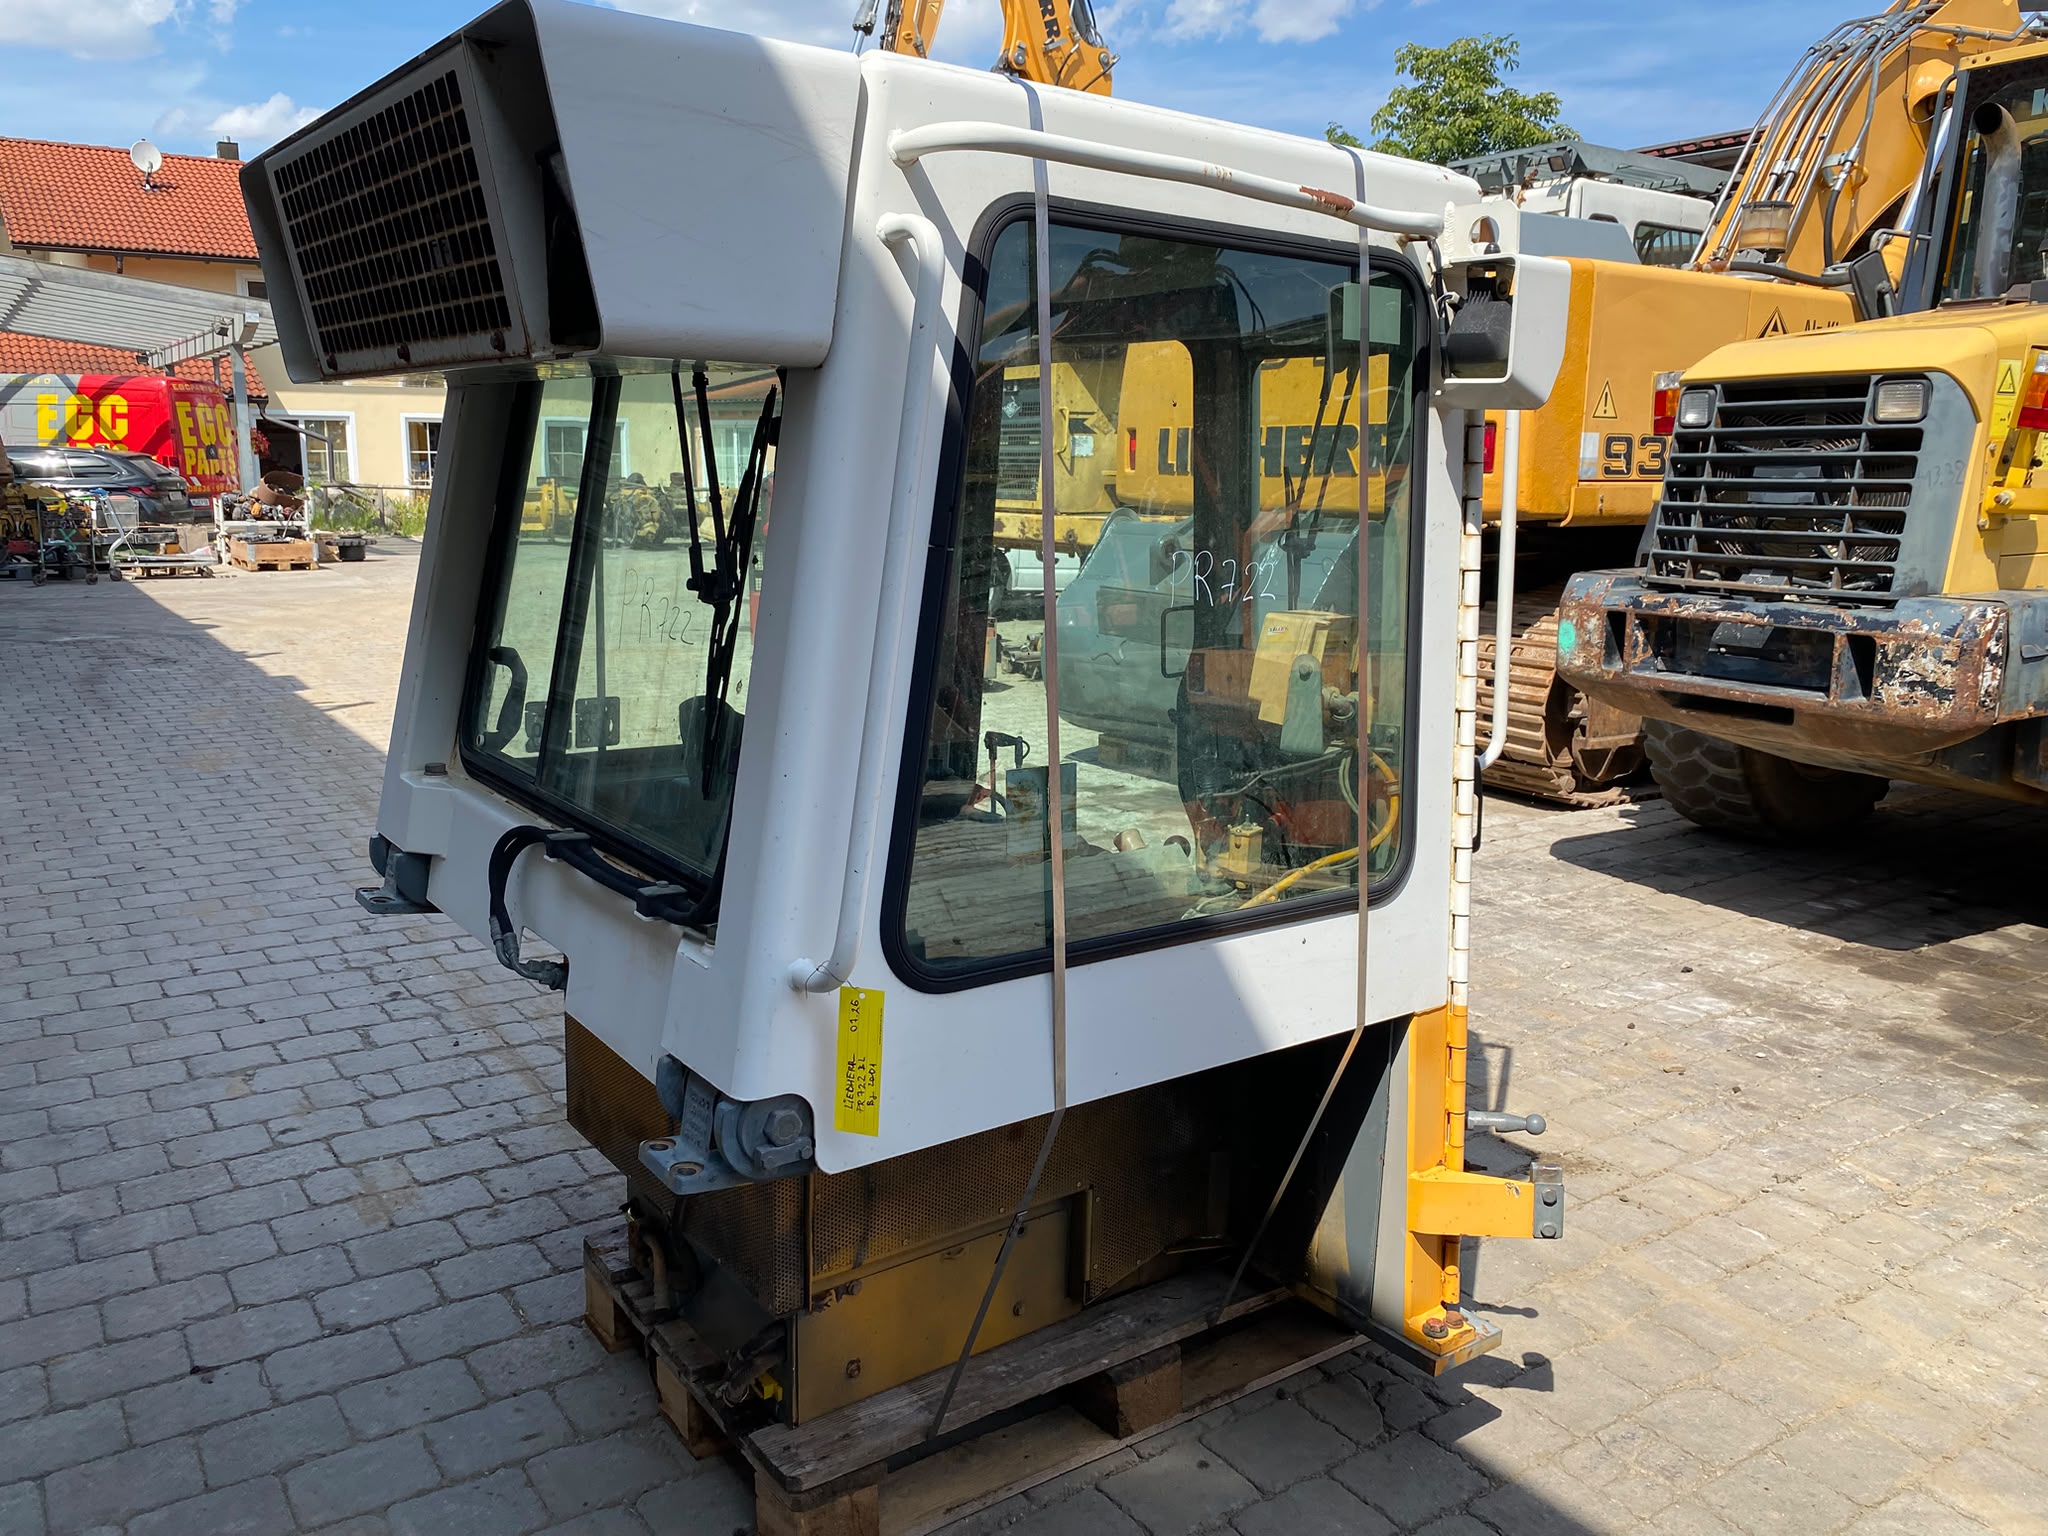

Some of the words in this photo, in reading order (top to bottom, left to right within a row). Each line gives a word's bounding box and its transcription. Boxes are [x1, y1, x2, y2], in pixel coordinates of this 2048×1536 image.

[36, 393, 129, 441] EGC
[175, 401, 233, 448] EGC
[1602, 433, 1668, 478] 93
[1170, 550, 1276, 608] PR722
[618, 568, 695, 651] PR722
[857, 1075, 867, 1097] 722
